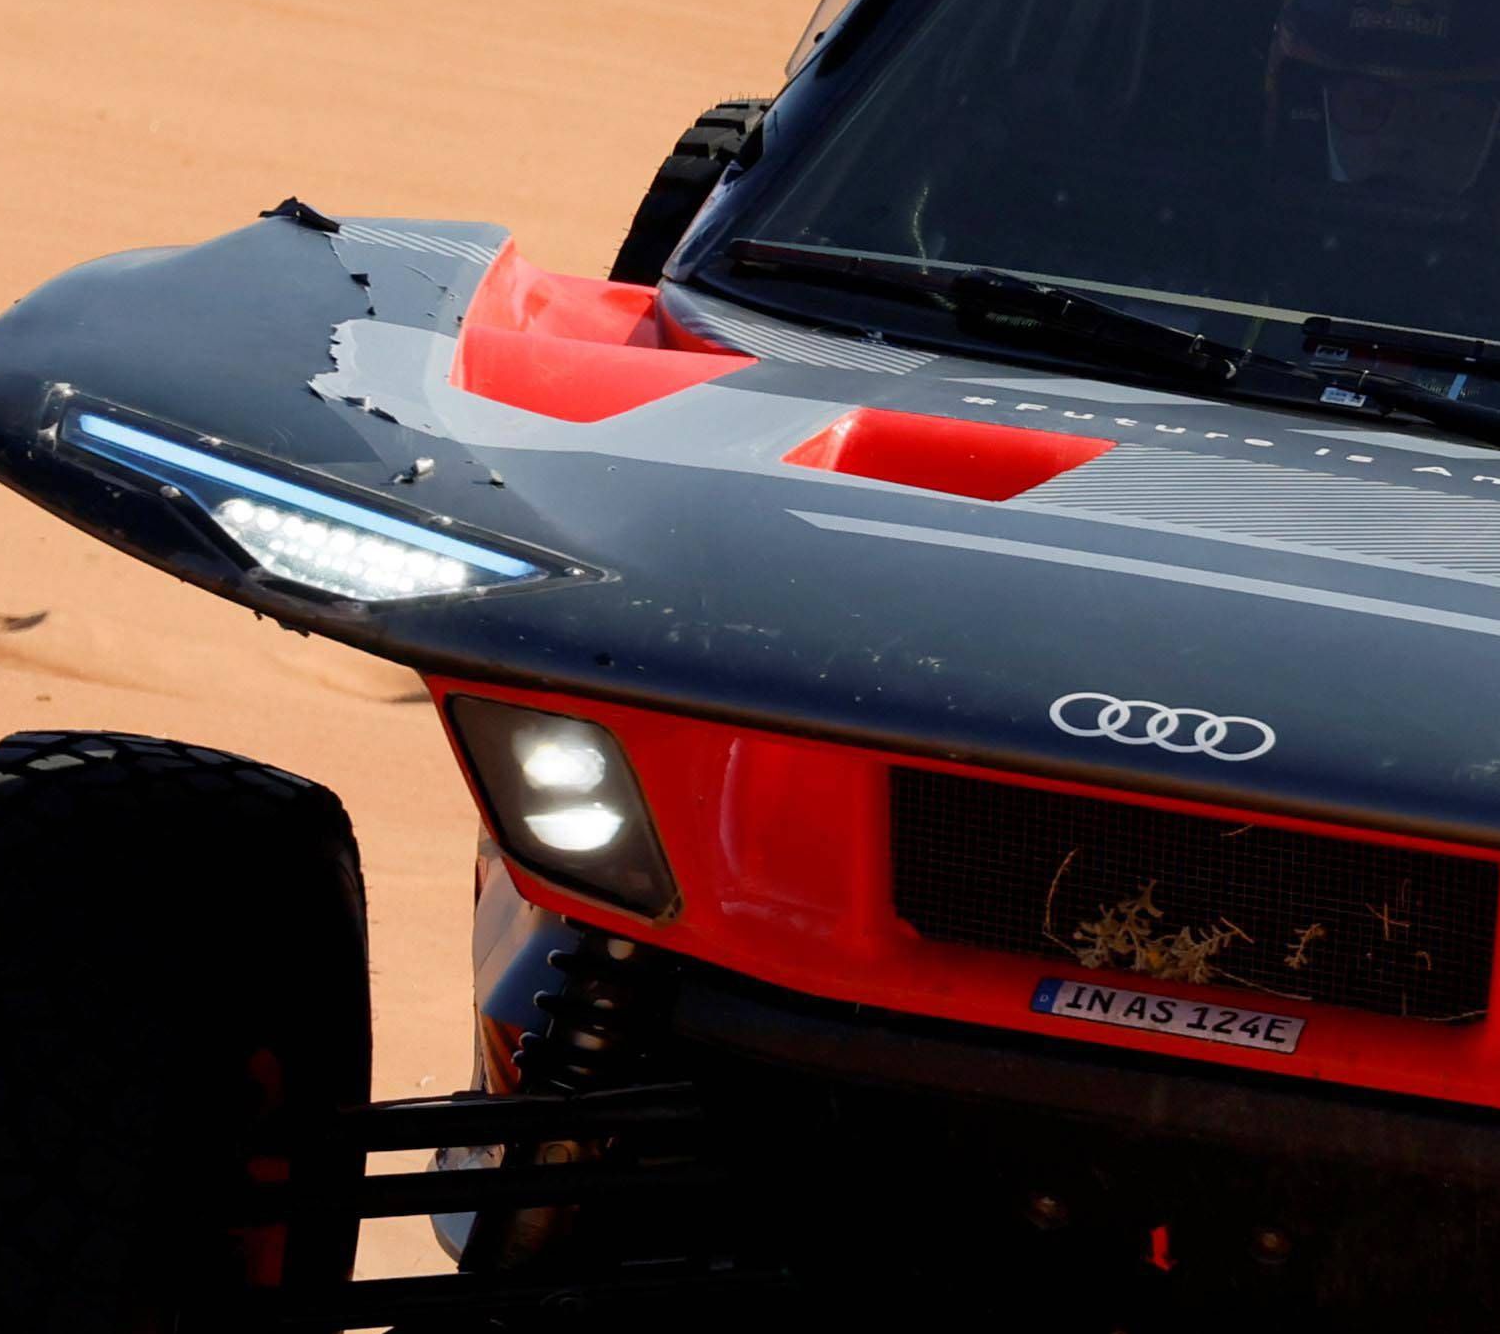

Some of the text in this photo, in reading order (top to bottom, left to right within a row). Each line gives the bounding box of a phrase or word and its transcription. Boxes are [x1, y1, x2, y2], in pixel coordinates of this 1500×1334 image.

[962, 396, 1274, 447] #Future
[1065, 985, 1294, 1044] IN AS 124E
